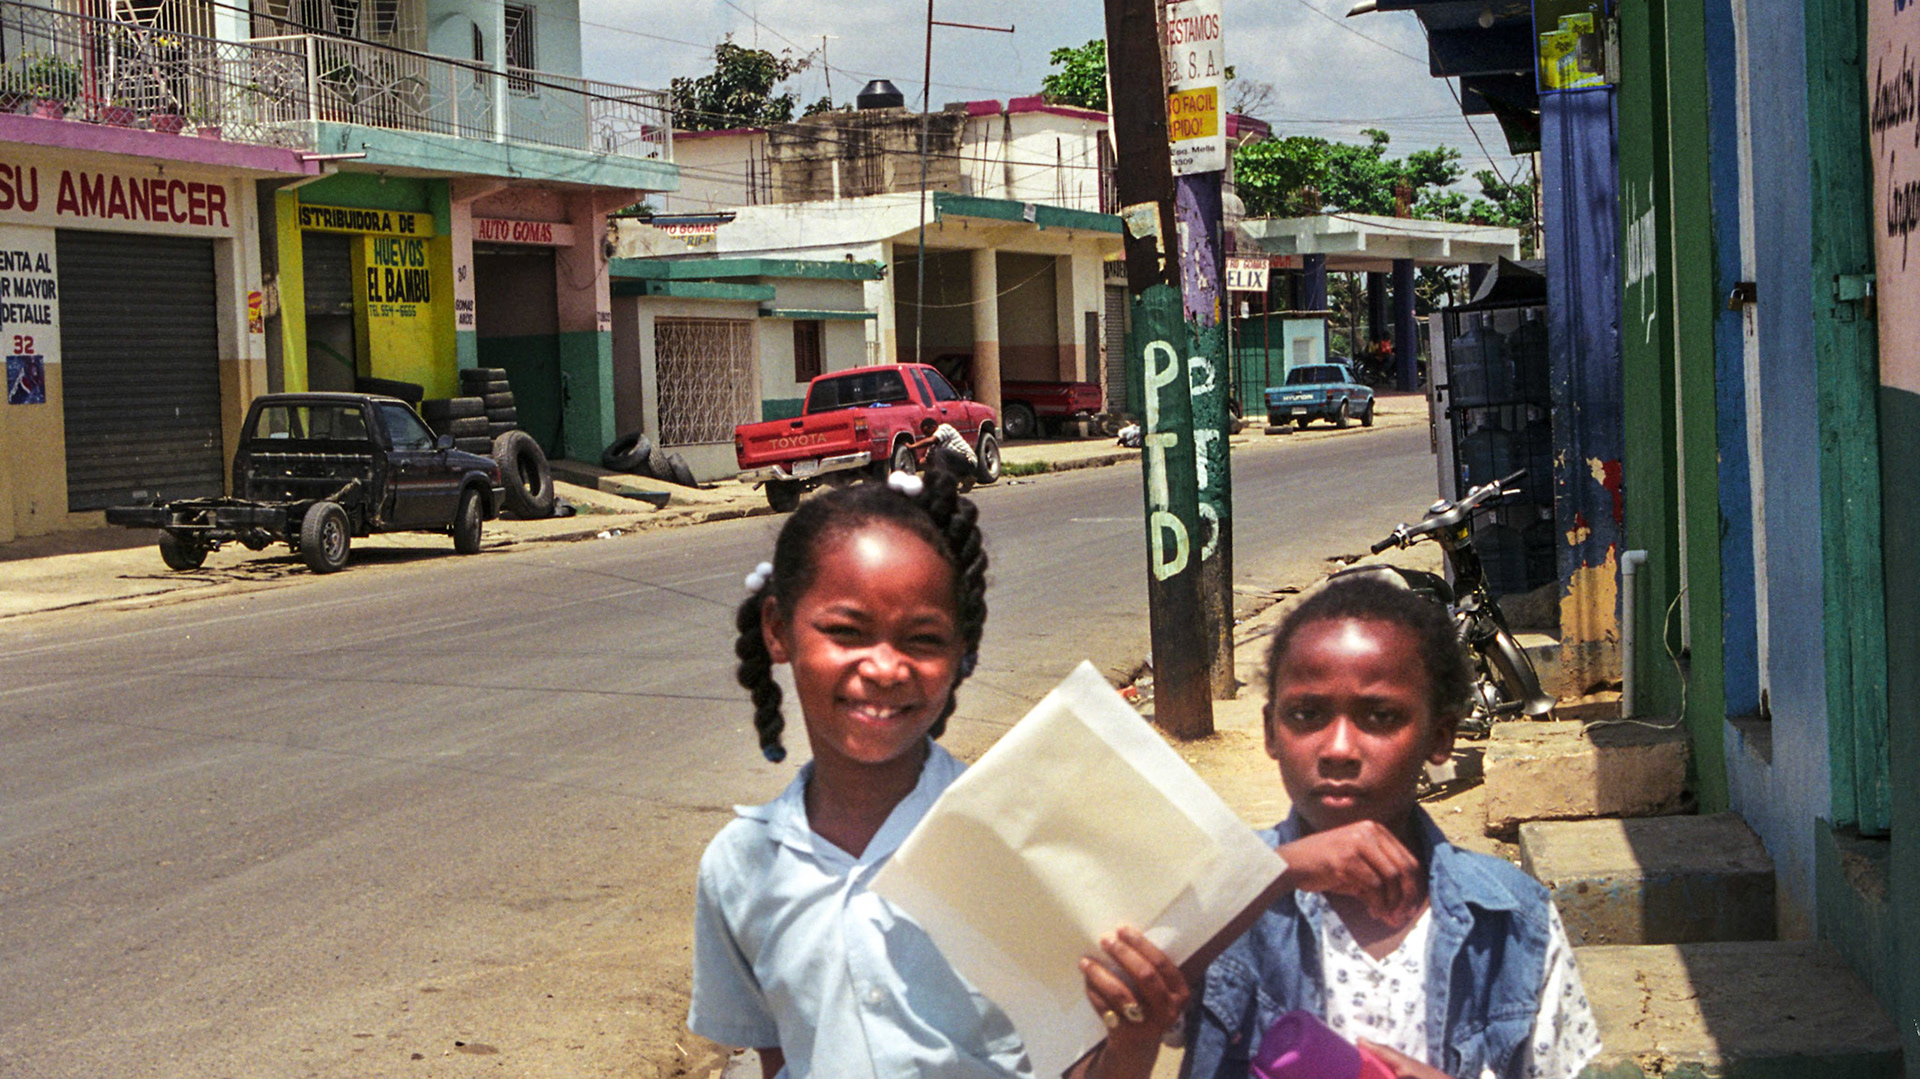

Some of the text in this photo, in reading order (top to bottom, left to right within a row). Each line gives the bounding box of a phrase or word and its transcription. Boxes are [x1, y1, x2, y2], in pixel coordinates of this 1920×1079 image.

[1182, 94, 1216, 113] FACIL
[0, 163, 230, 228] SU AMANECER
[399, 213, 416, 234] DE
[479, 219, 553, 242] AUTO GOMAS
[679, 223, 718, 234] GOMAS
[35, 252, 52, 274] AL
[374, 238, 425, 267] HUEVOS
[13, 277, 56, 300] MAYOR
[367, 267, 431, 304] EL BAMBU
[1227, 270, 1263, 288] ELIX
[1, 303, 52, 325] DETALLE
[13, 335, 35, 355] 32
[769, 432, 828, 450] TOYOTA
